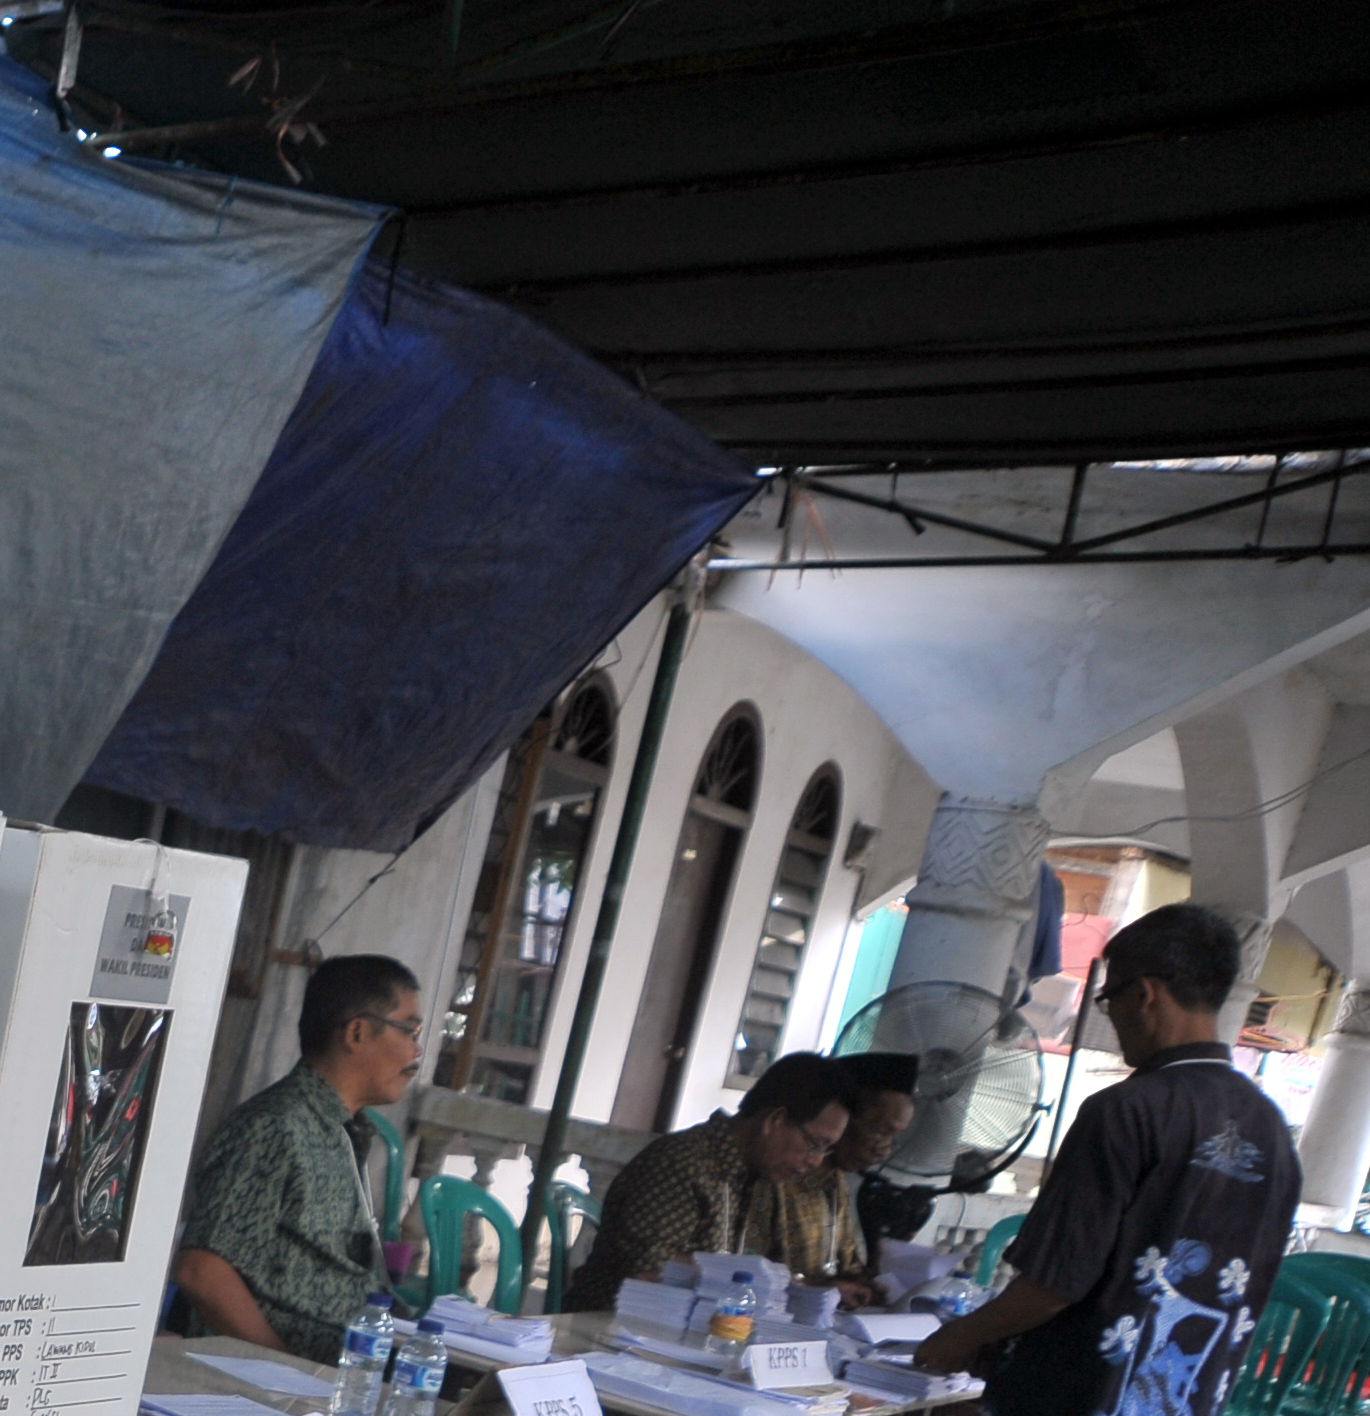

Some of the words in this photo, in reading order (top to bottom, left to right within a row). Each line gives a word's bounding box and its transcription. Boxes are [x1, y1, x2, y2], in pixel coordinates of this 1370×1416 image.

[100, 958, 129, 975] WAKIL
[130, 961, 171, 979] PRESIDEN
[17, 1293, 45, 1311] Kotak
[13, 1319, 32, 1336] TPS
[1, 1344, 23, 1362] PPS
[769, 1347, 798, 1369] KPPS
[802, 1347, 807, 1367] 1
